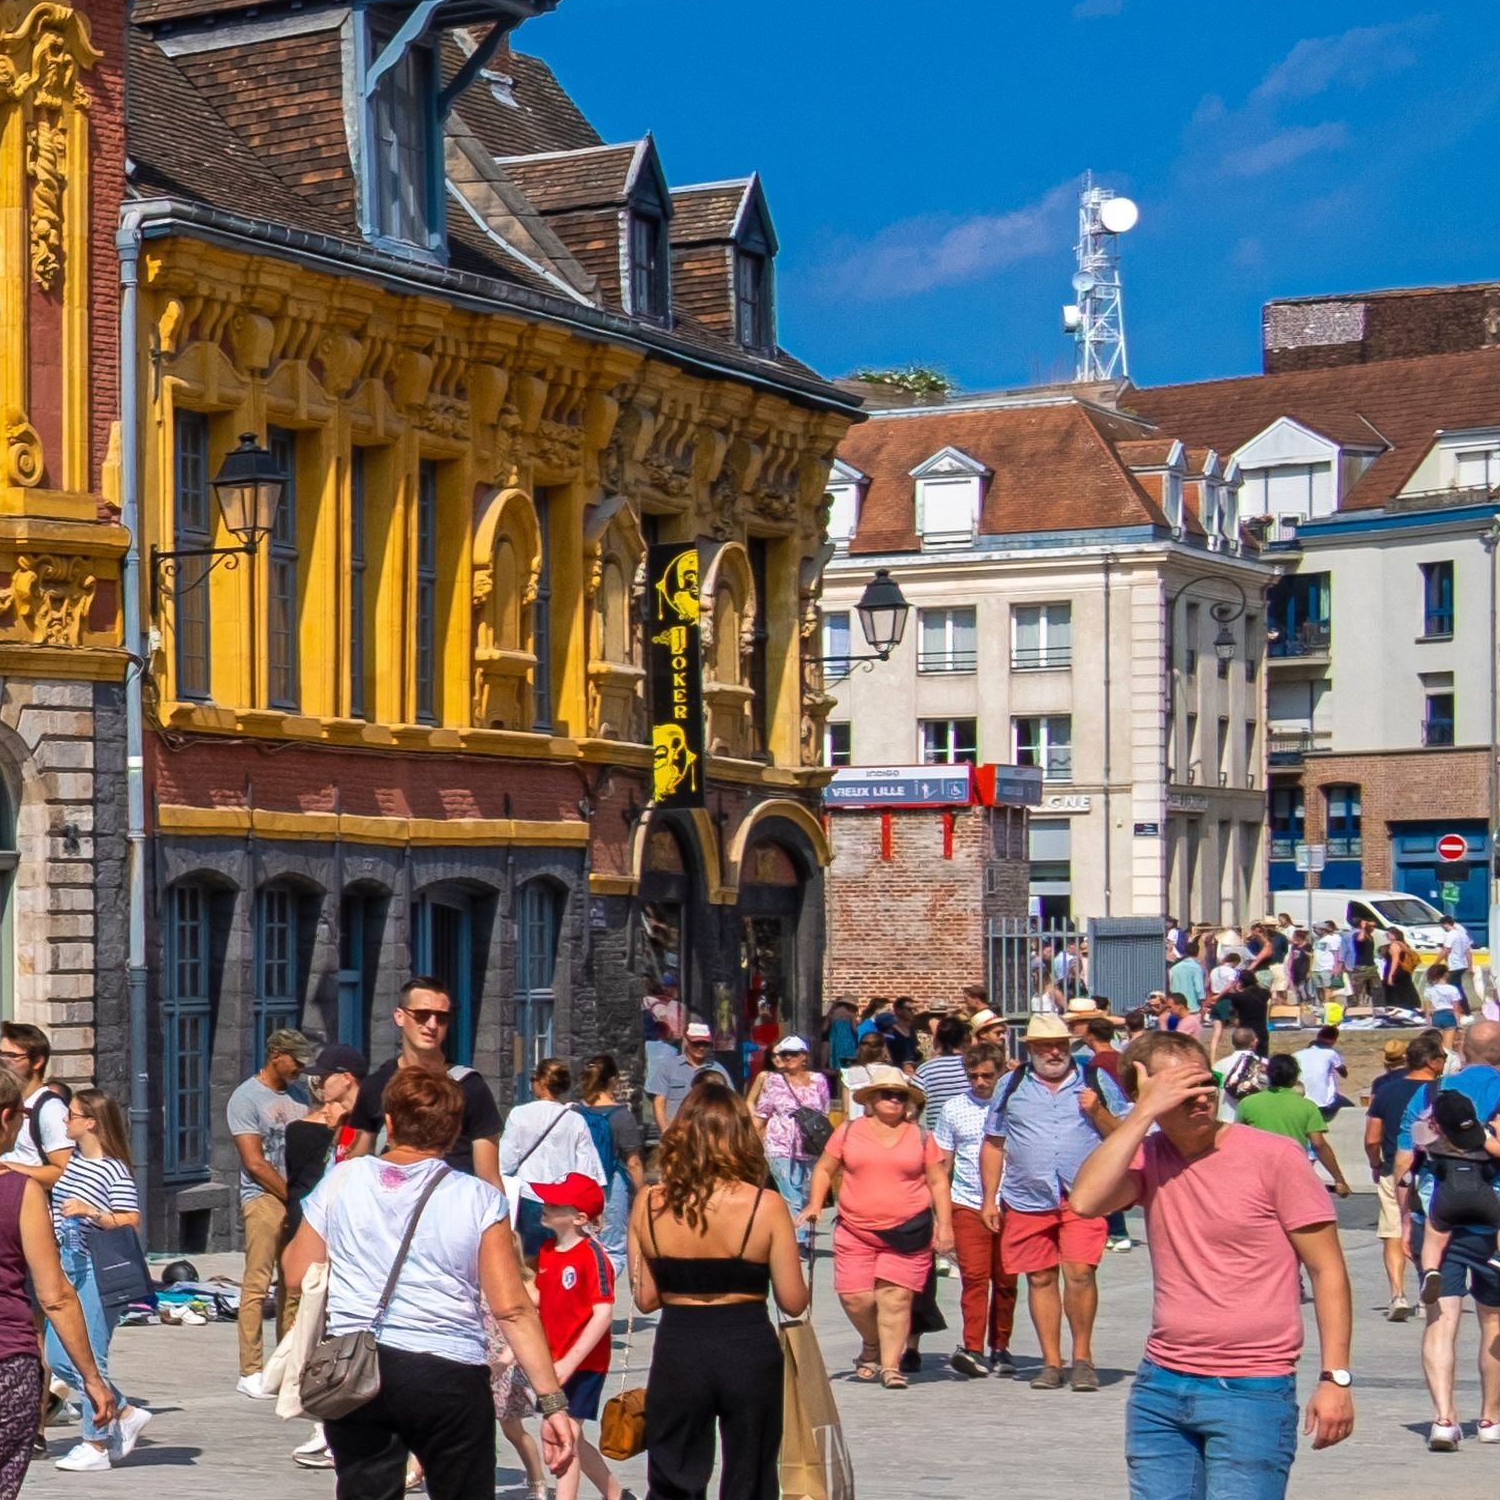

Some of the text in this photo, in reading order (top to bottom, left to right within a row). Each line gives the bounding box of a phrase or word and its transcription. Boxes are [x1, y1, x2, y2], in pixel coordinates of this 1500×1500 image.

[671, 626, 688, 719] JOKER
[831, 785, 905, 797] VIEUX LILLE
